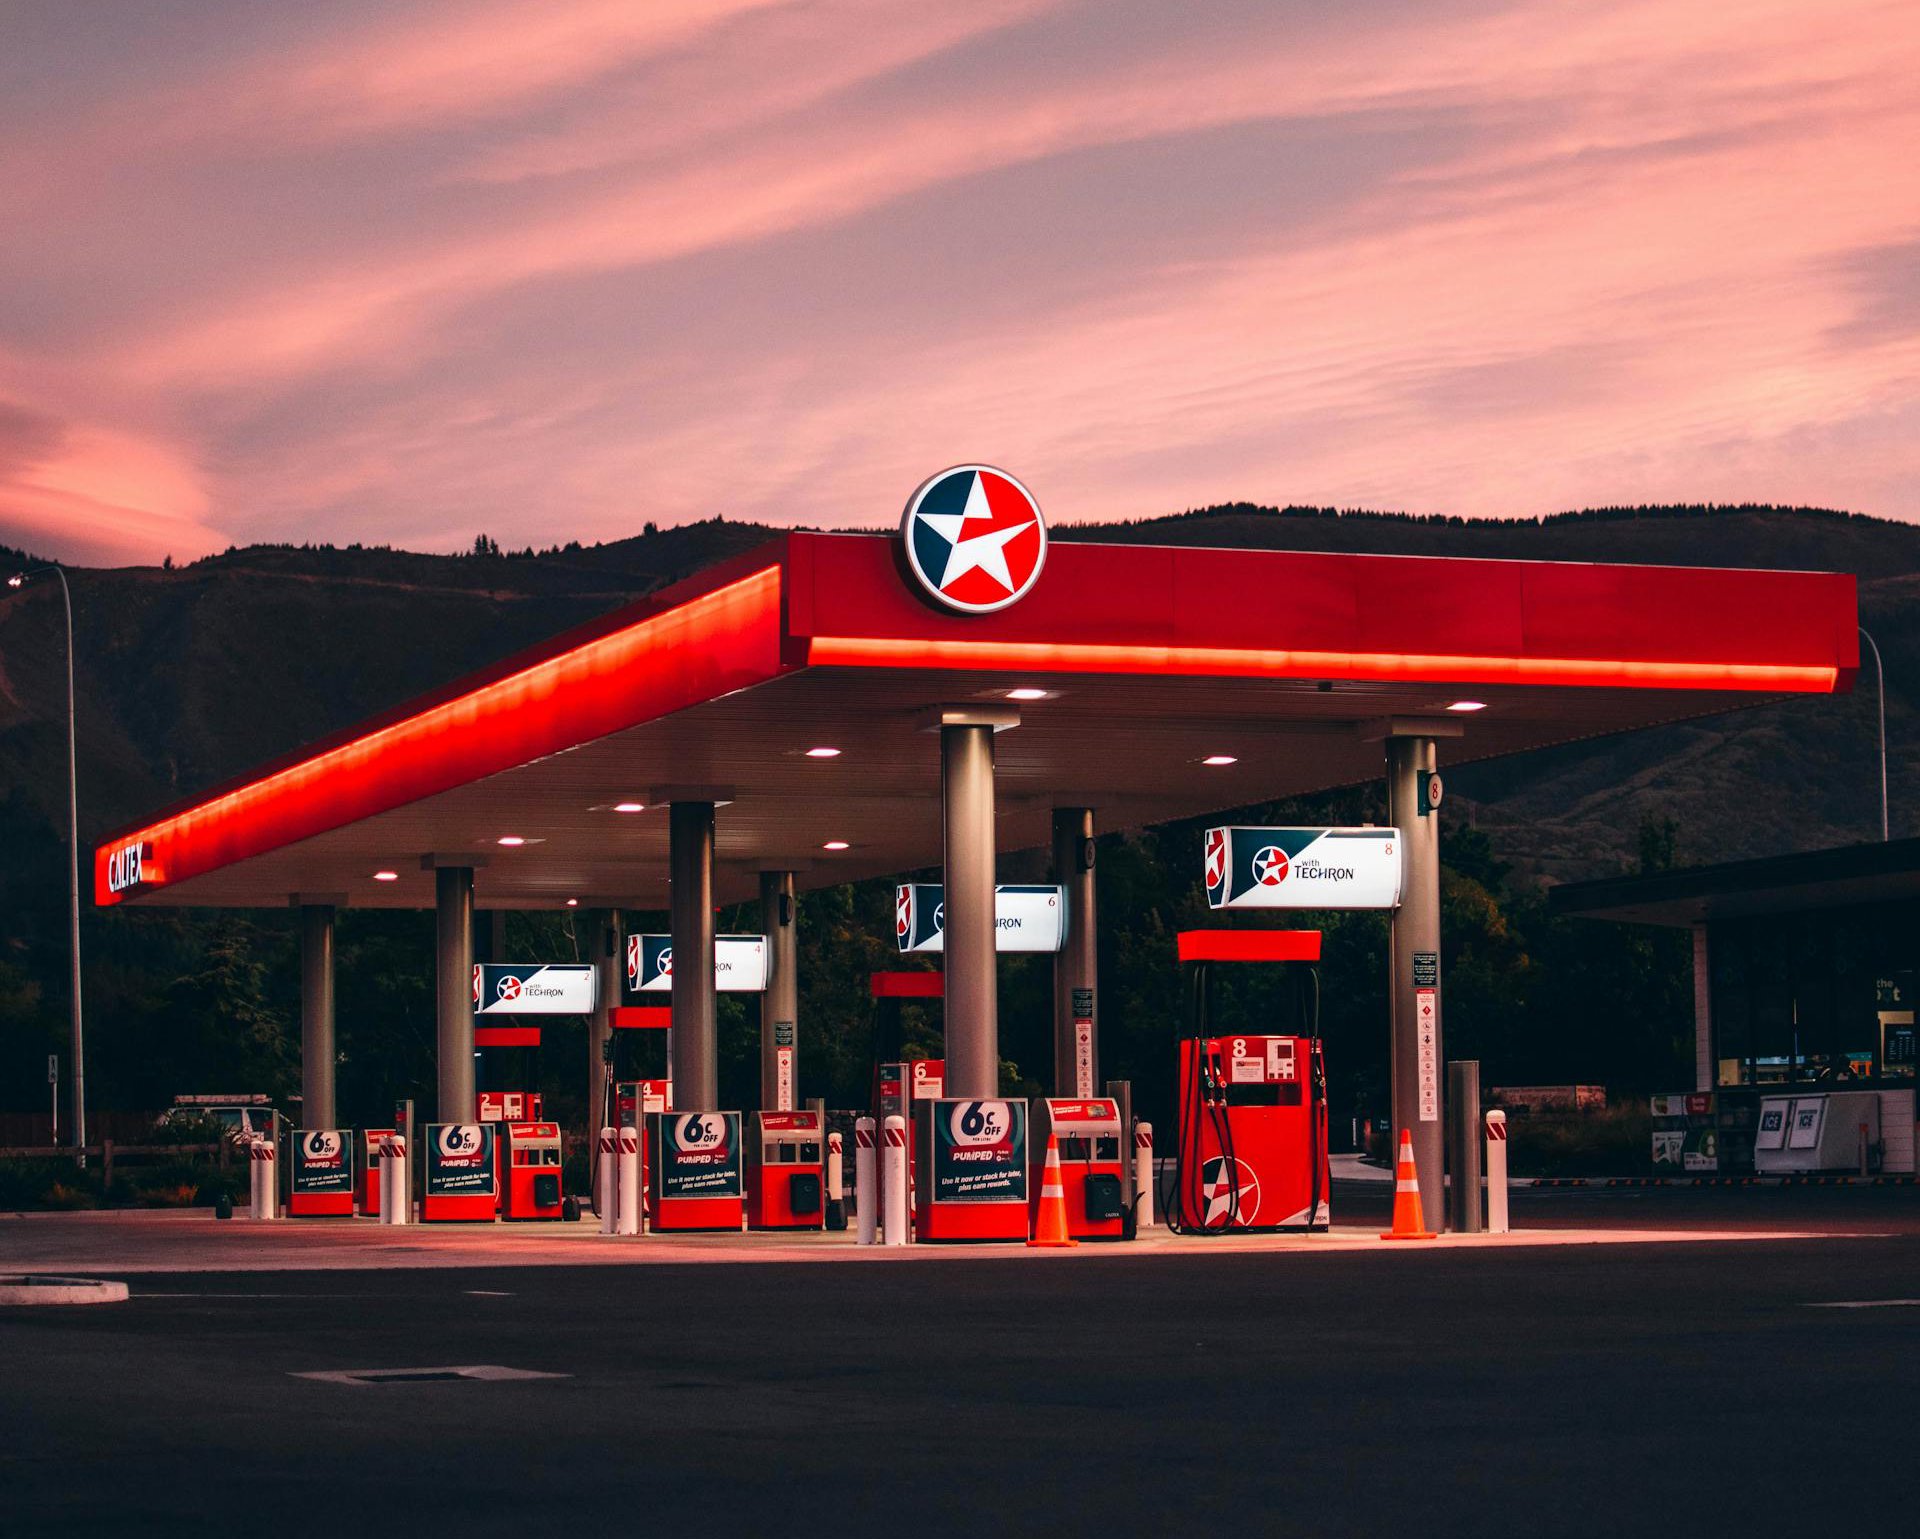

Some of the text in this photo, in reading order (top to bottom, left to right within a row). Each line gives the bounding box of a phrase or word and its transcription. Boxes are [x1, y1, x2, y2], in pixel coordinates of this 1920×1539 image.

[1432, 783, 1438, 800] 8
[1385, 843, 1393, 855] 8
[108, 842, 143, 892] CALTEX
[1294, 866, 1354, 881] TECHRON
[1048, 896, 1056, 907] 6
[524, 988, 564, 998] TECHRON
[1233, 1038, 1247, 1058] 8
[914, 1062, 927, 1079] 6
[642, 1082, 653, 1095] 4
[481, 1094, 491, 1105] 2
[984, 1126, 1001, 1136] OFF
[703, 1134, 718, 1143] OFF
[677, 1154, 711, 1164] PUMPED
[952, 1150, 993, 1161] PUMPED
[440, 1159, 470, 1167] PUMPED
[941, 1177, 954, 1185] Use
[982, 1172, 998, 1181] stack
[998, 1171, 1008, 1179] for
[958, 1184, 972, 1192] plus
[972, 1182, 987, 1190] earn
